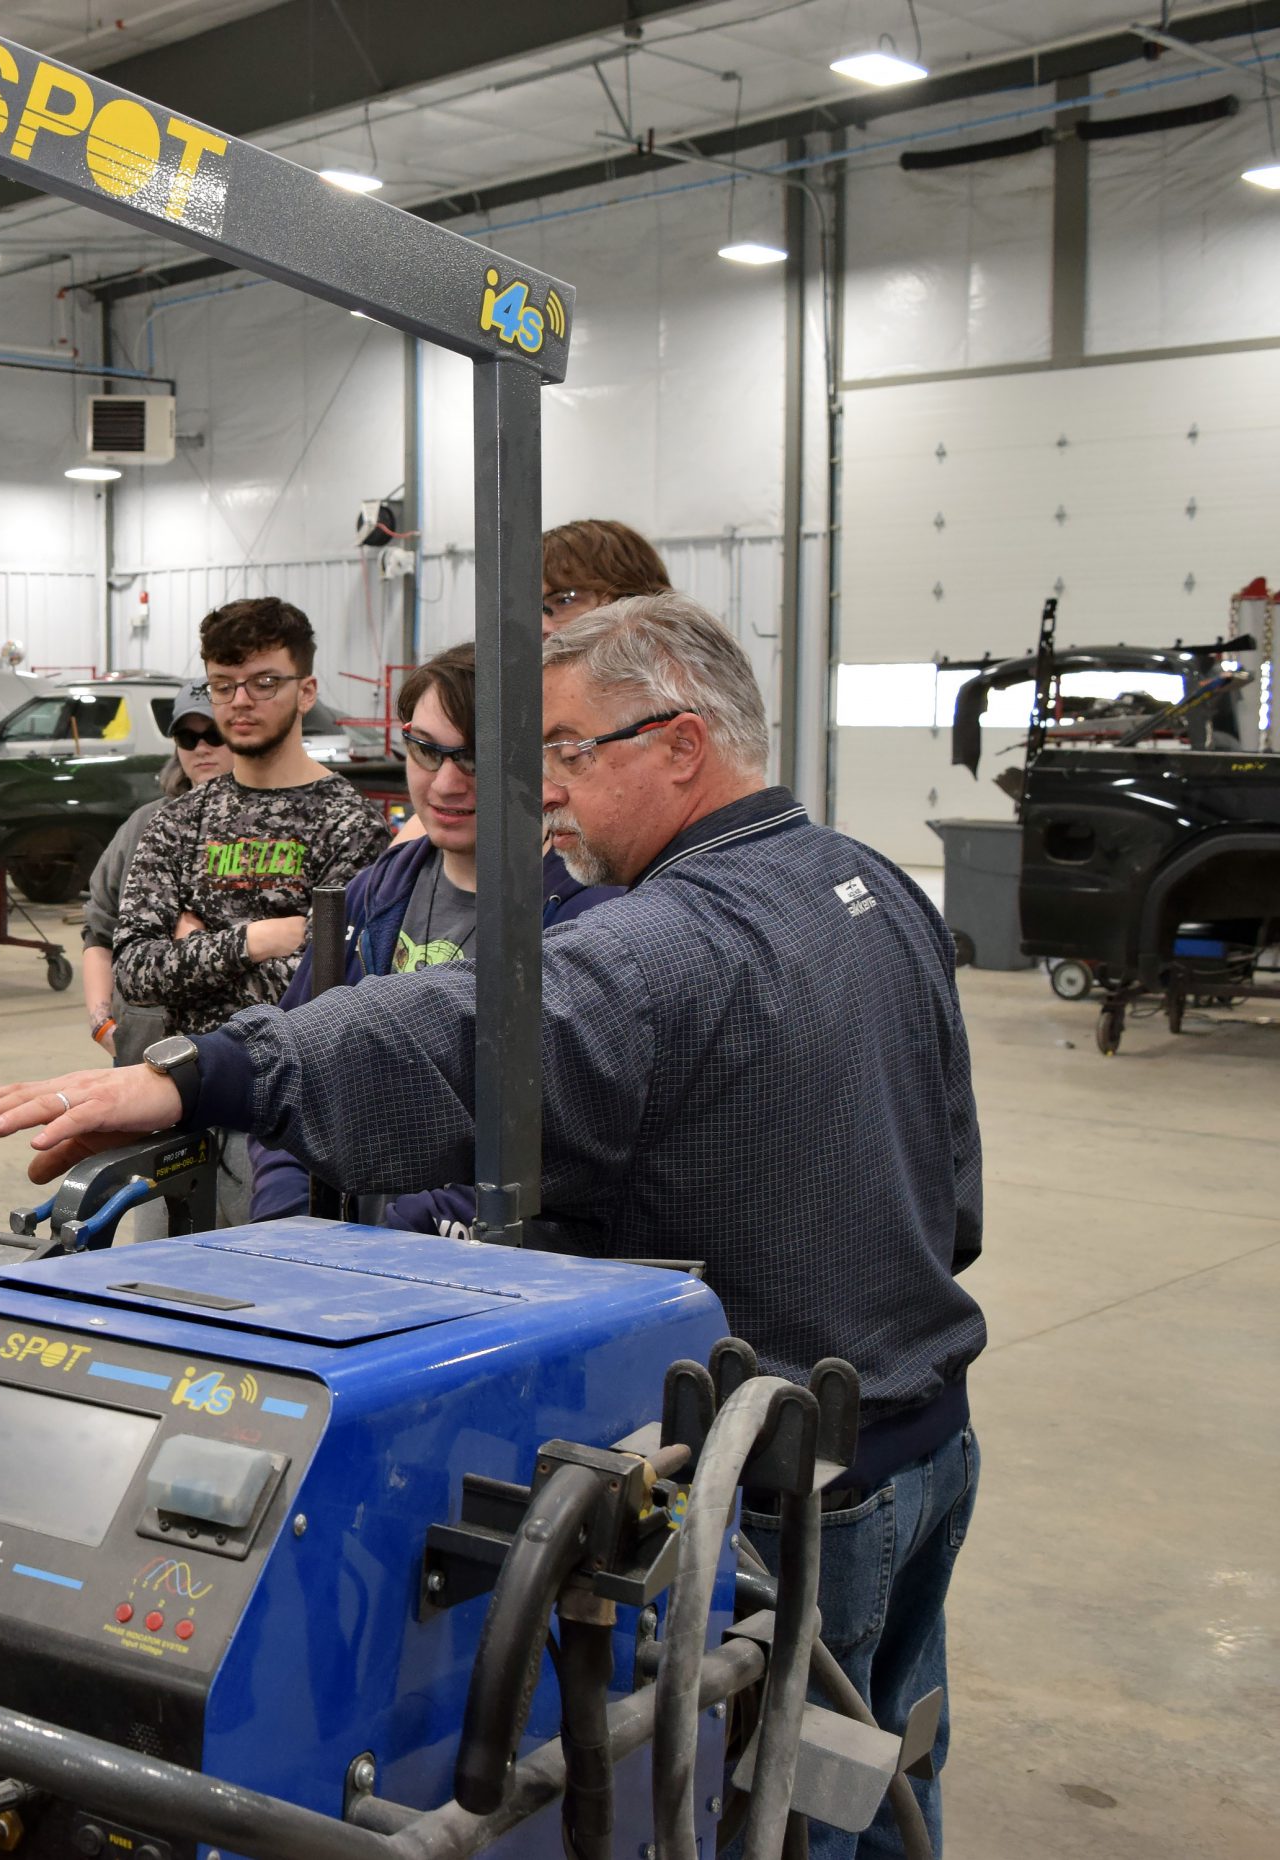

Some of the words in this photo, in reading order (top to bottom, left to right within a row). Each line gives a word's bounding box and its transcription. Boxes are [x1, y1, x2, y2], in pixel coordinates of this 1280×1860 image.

[480, 268, 545, 353] i4s
[0, 1332, 93, 1372] SPOT
[171, 1366, 236, 1416] i4s
[103, 1623, 126, 1636] PHASE
[126, 1630, 162, 1646] INDICATOR
[161, 1640, 189, 1655] SYSTEM
[120, 1637, 140, 1649] Input
[138, 1642, 164, 1657] Voltage
[109, 1833, 133, 1850] FUSES
